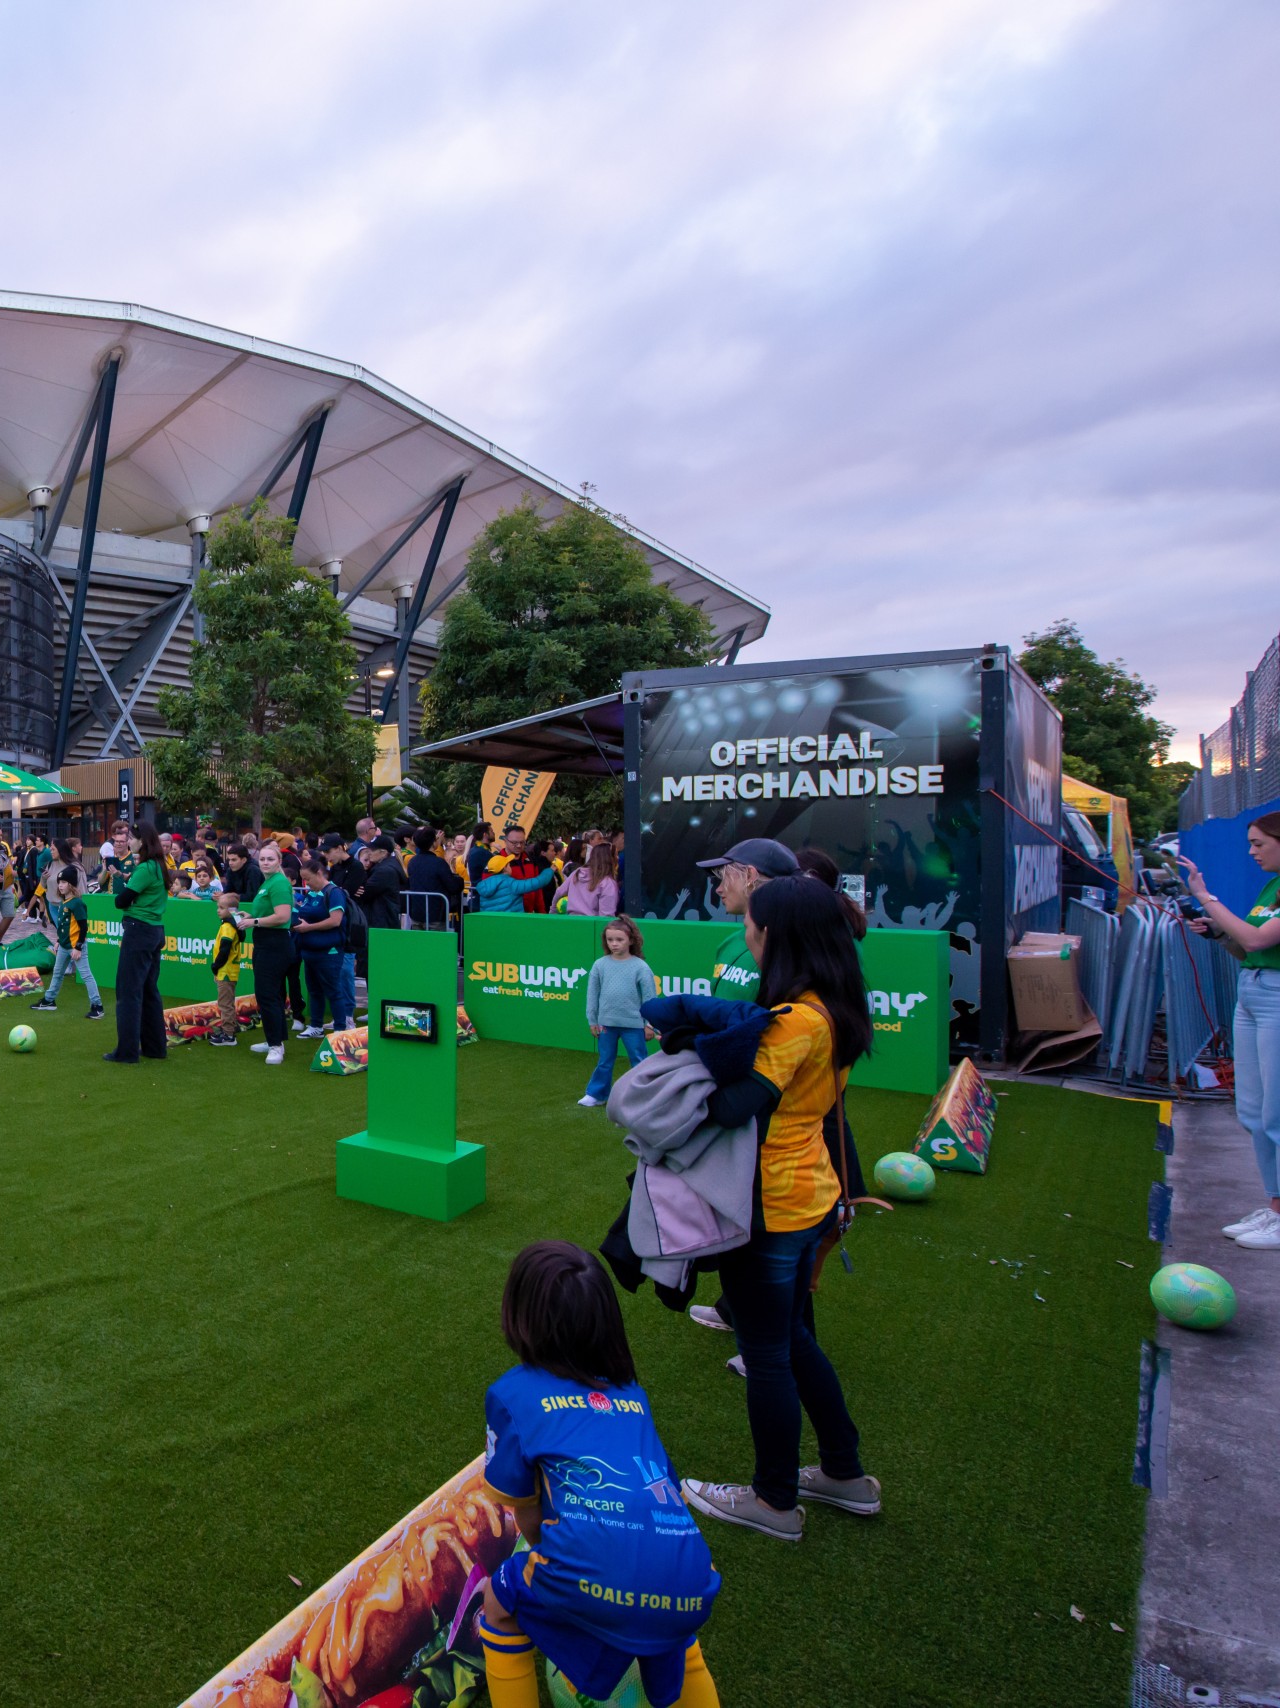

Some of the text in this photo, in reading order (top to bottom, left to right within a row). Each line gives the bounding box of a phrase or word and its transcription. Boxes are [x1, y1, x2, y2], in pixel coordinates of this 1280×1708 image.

[710, 732, 883, 767] OFFICIAL
[121, 784, 129, 801] B
[491, 767, 521, 817] OFFICIA
[662, 765, 945, 802] MERCHANDISE
[468, 960, 588, 989] SUBWAY
[524, 988, 570, 1002] feelgood
[541, 1395, 645, 1416] SINCE 1901
[564, 1492, 625, 1513] Paracare
[626, 1521, 645, 1531] care
[578, 1578, 703, 1612] GOALS FOR LIFE
